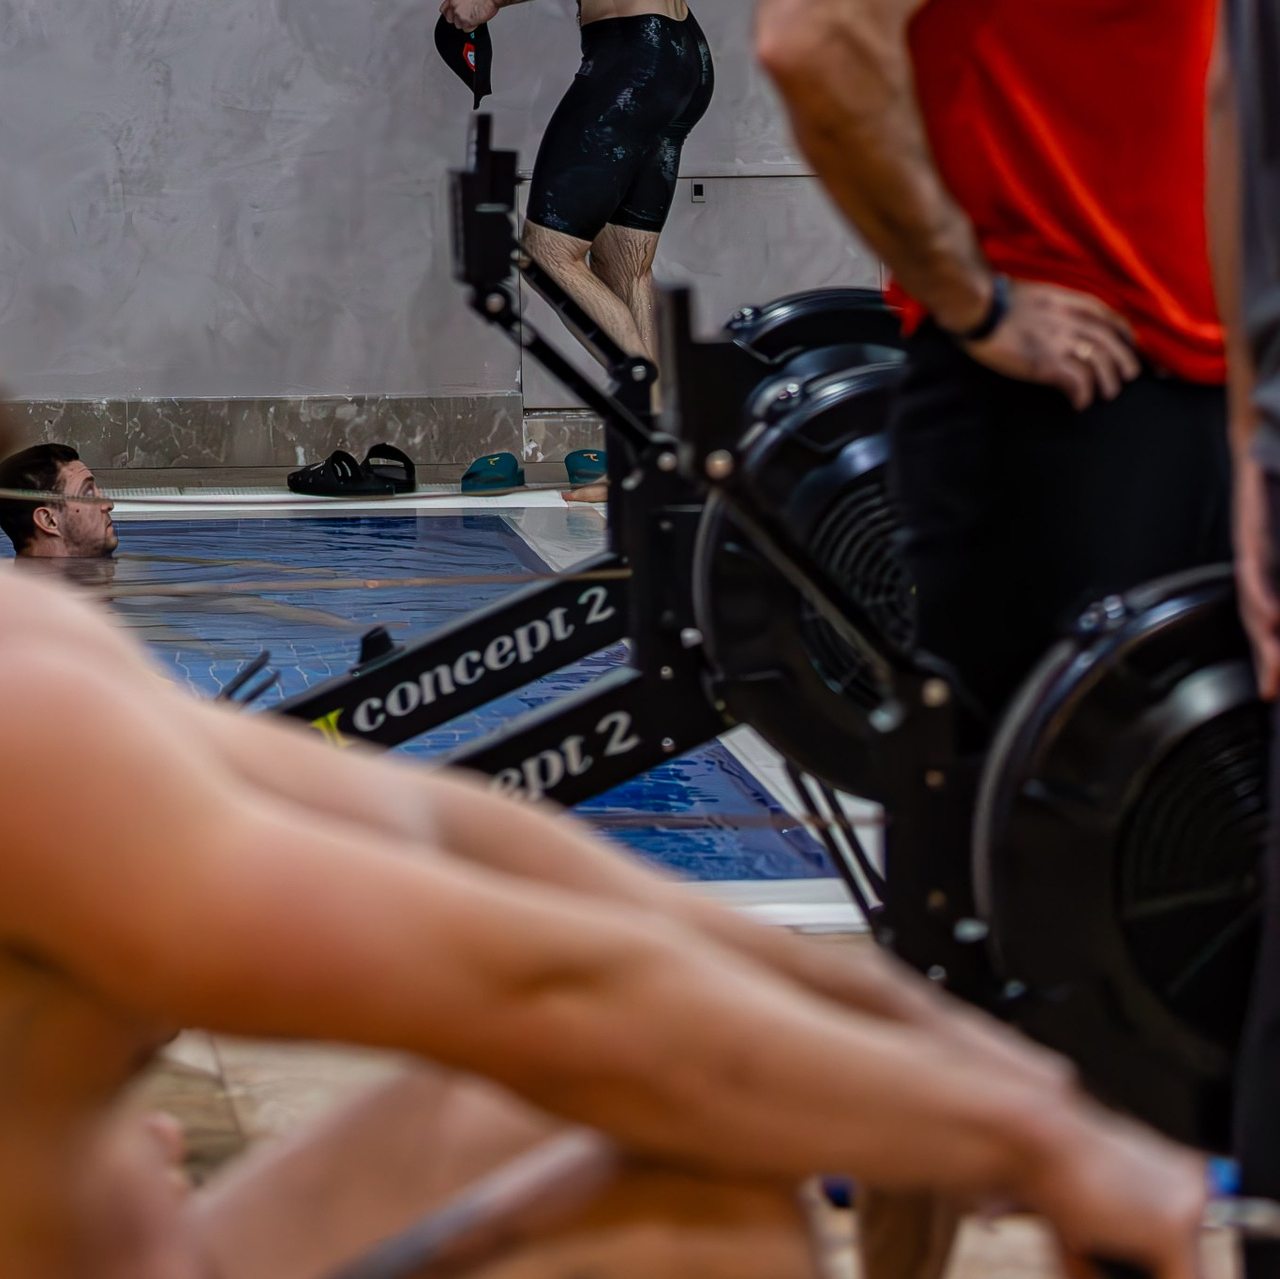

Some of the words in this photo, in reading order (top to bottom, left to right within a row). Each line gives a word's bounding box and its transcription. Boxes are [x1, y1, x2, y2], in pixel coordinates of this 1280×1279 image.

[352, 607, 575, 732] concept
[578, 586, 616, 624] 2
[595, 710, 640, 756] 2
